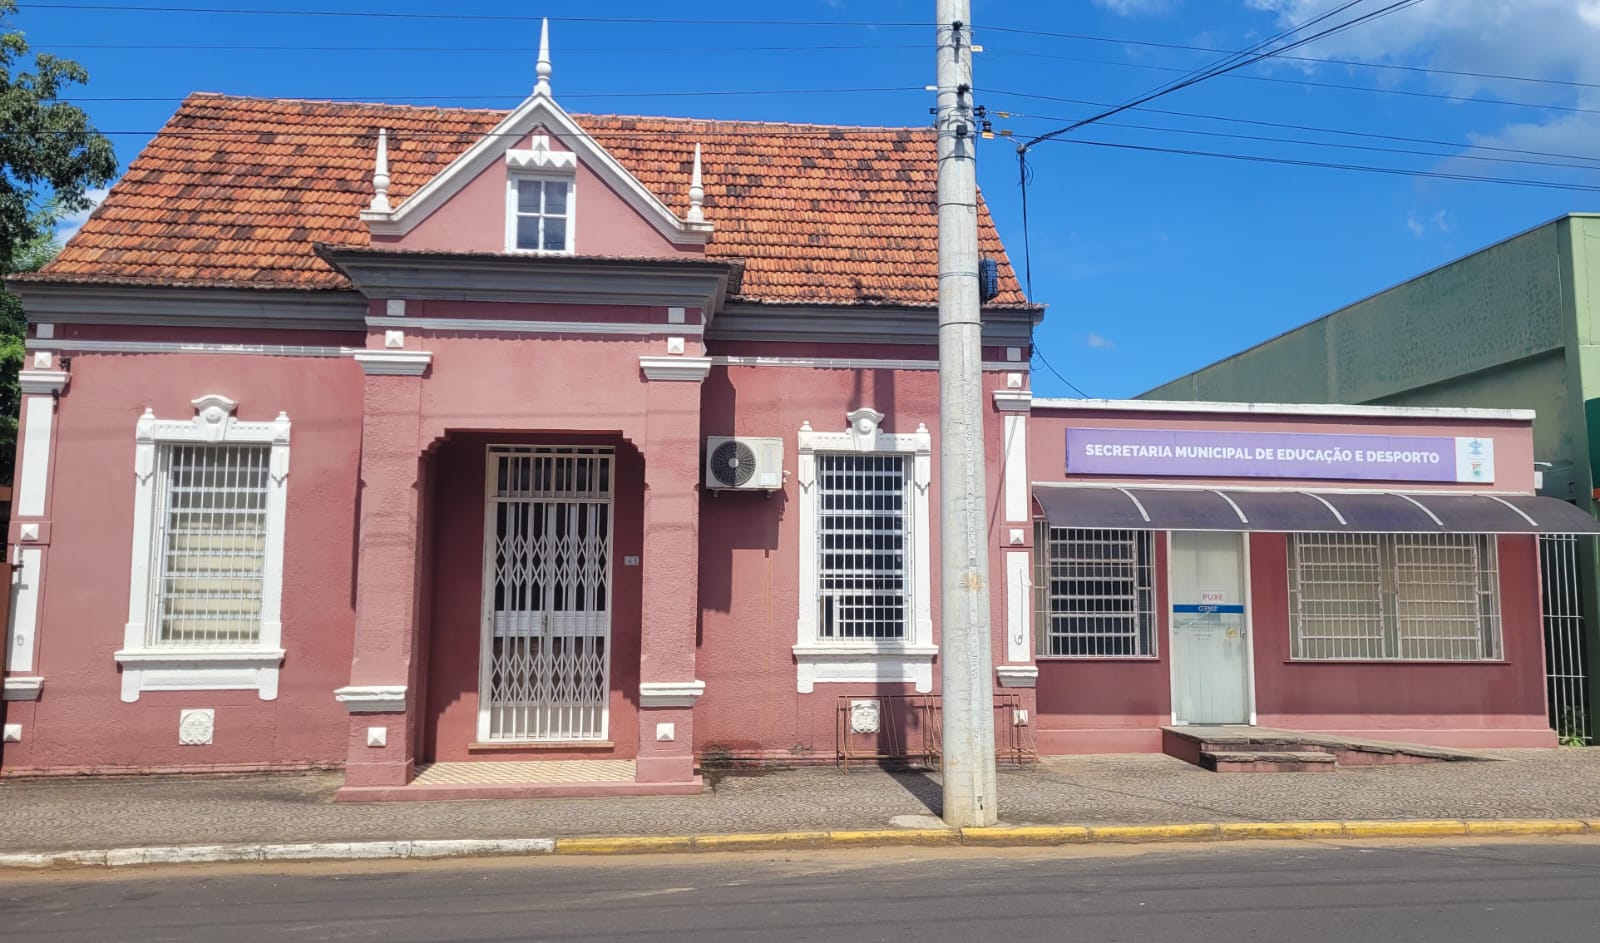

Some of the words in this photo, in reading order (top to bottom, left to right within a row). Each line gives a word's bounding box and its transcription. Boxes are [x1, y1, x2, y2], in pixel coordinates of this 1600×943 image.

[1086, 444, 1172, 457] SECRETARIA
[1176, 447, 1253, 460] MUNICIPAL
[1256, 448, 1274, 461] DE
[1277, 448, 1352, 464] EDUCAÇÃO
[1355, 450, 1363, 462] E
[1367, 450, 1440, 464] DESPORTO
[1202, 593, 1224, 601] PUXE
